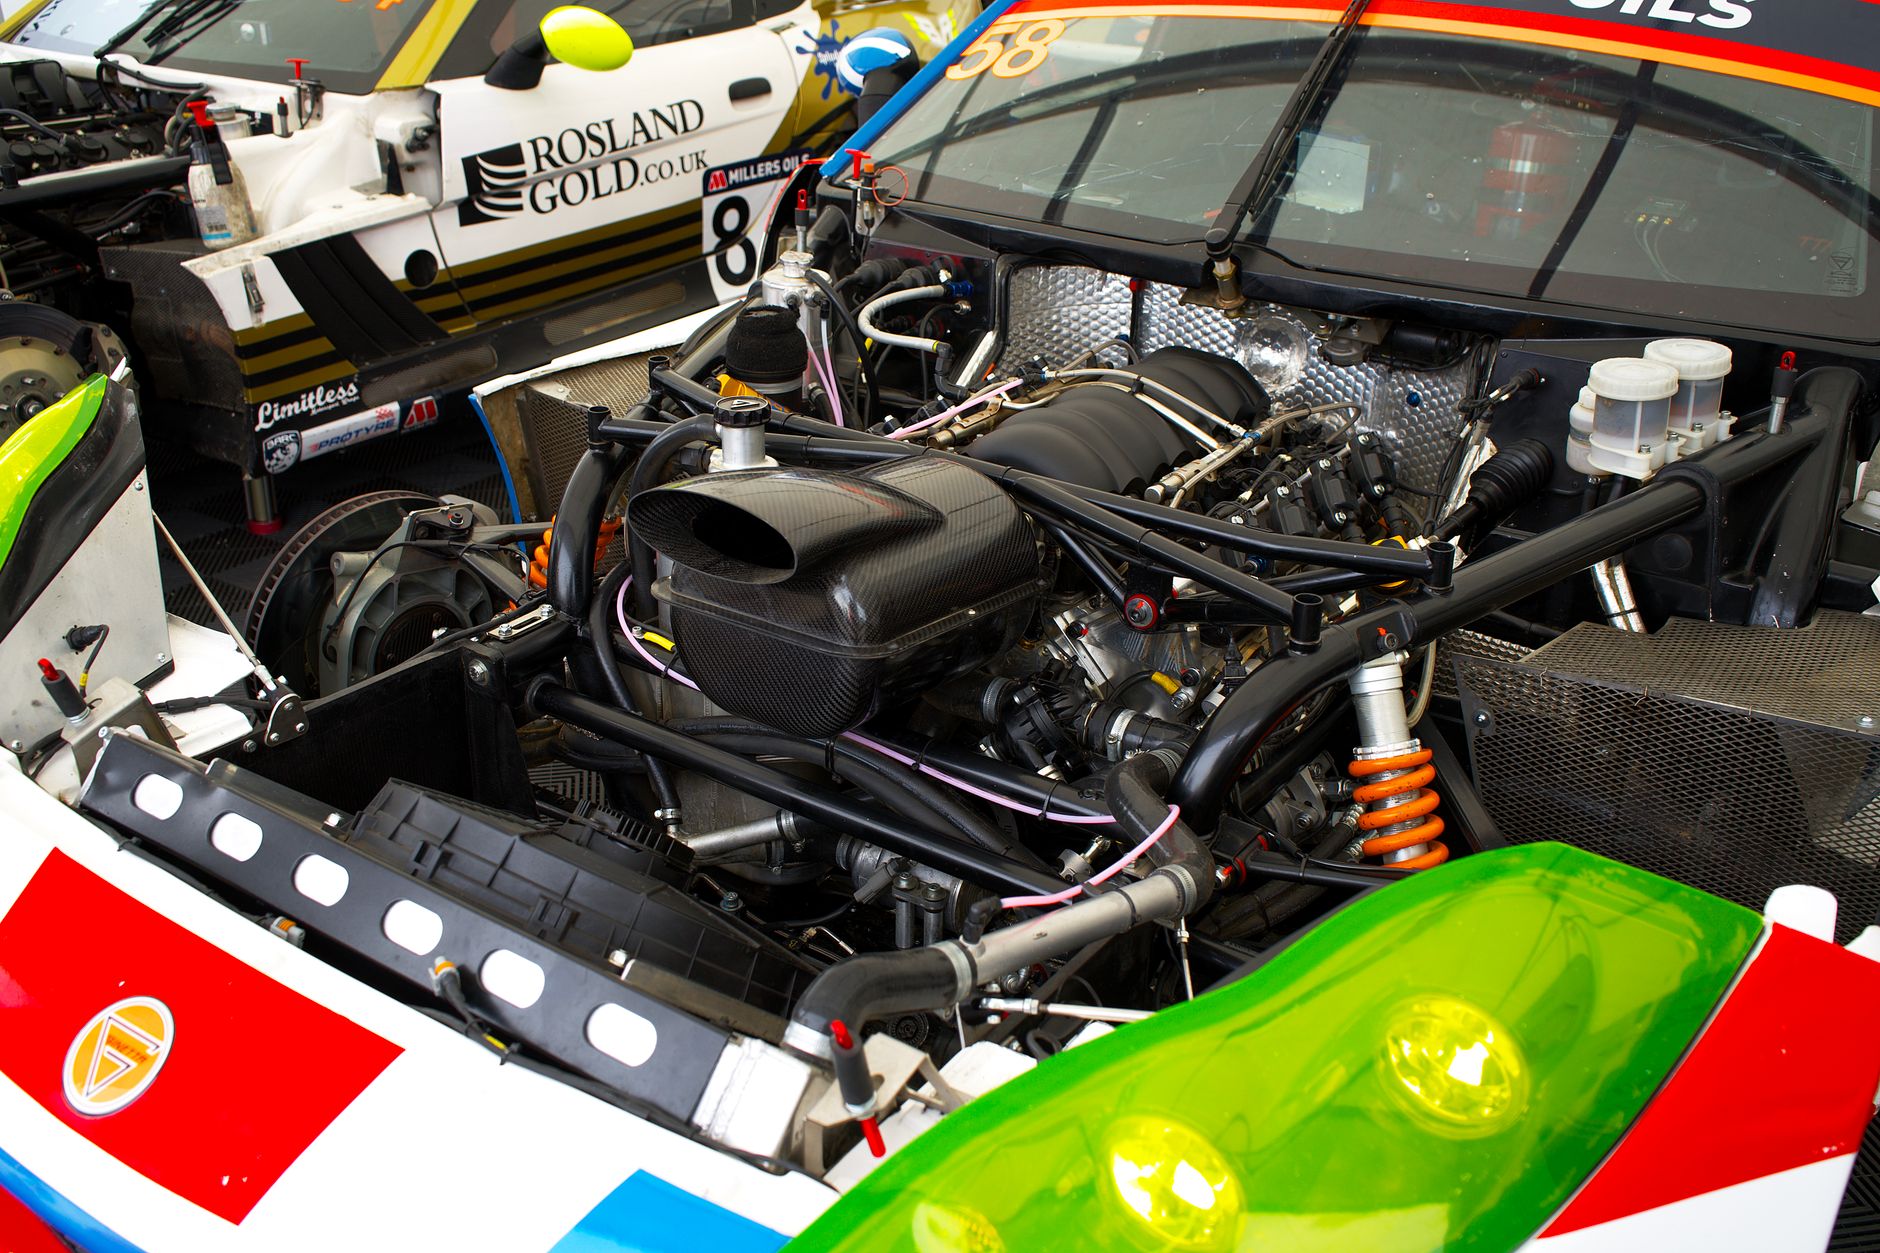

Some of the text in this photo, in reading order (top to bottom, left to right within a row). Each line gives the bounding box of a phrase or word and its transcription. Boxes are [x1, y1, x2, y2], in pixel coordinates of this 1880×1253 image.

[946, 18, 1065, 80] 58
[527, 99, 704, 174] ROSLAND
[529, 150, 708, 204] GOLD.CO.UK
[728, 159, 780, 185] MILLERS
[713, 195, 757, 286] 8
[255, 381, 358, 432] Limitless
[267, 433, 297, 450] BARC
[318, 419, 396, 450] PROTYRE
